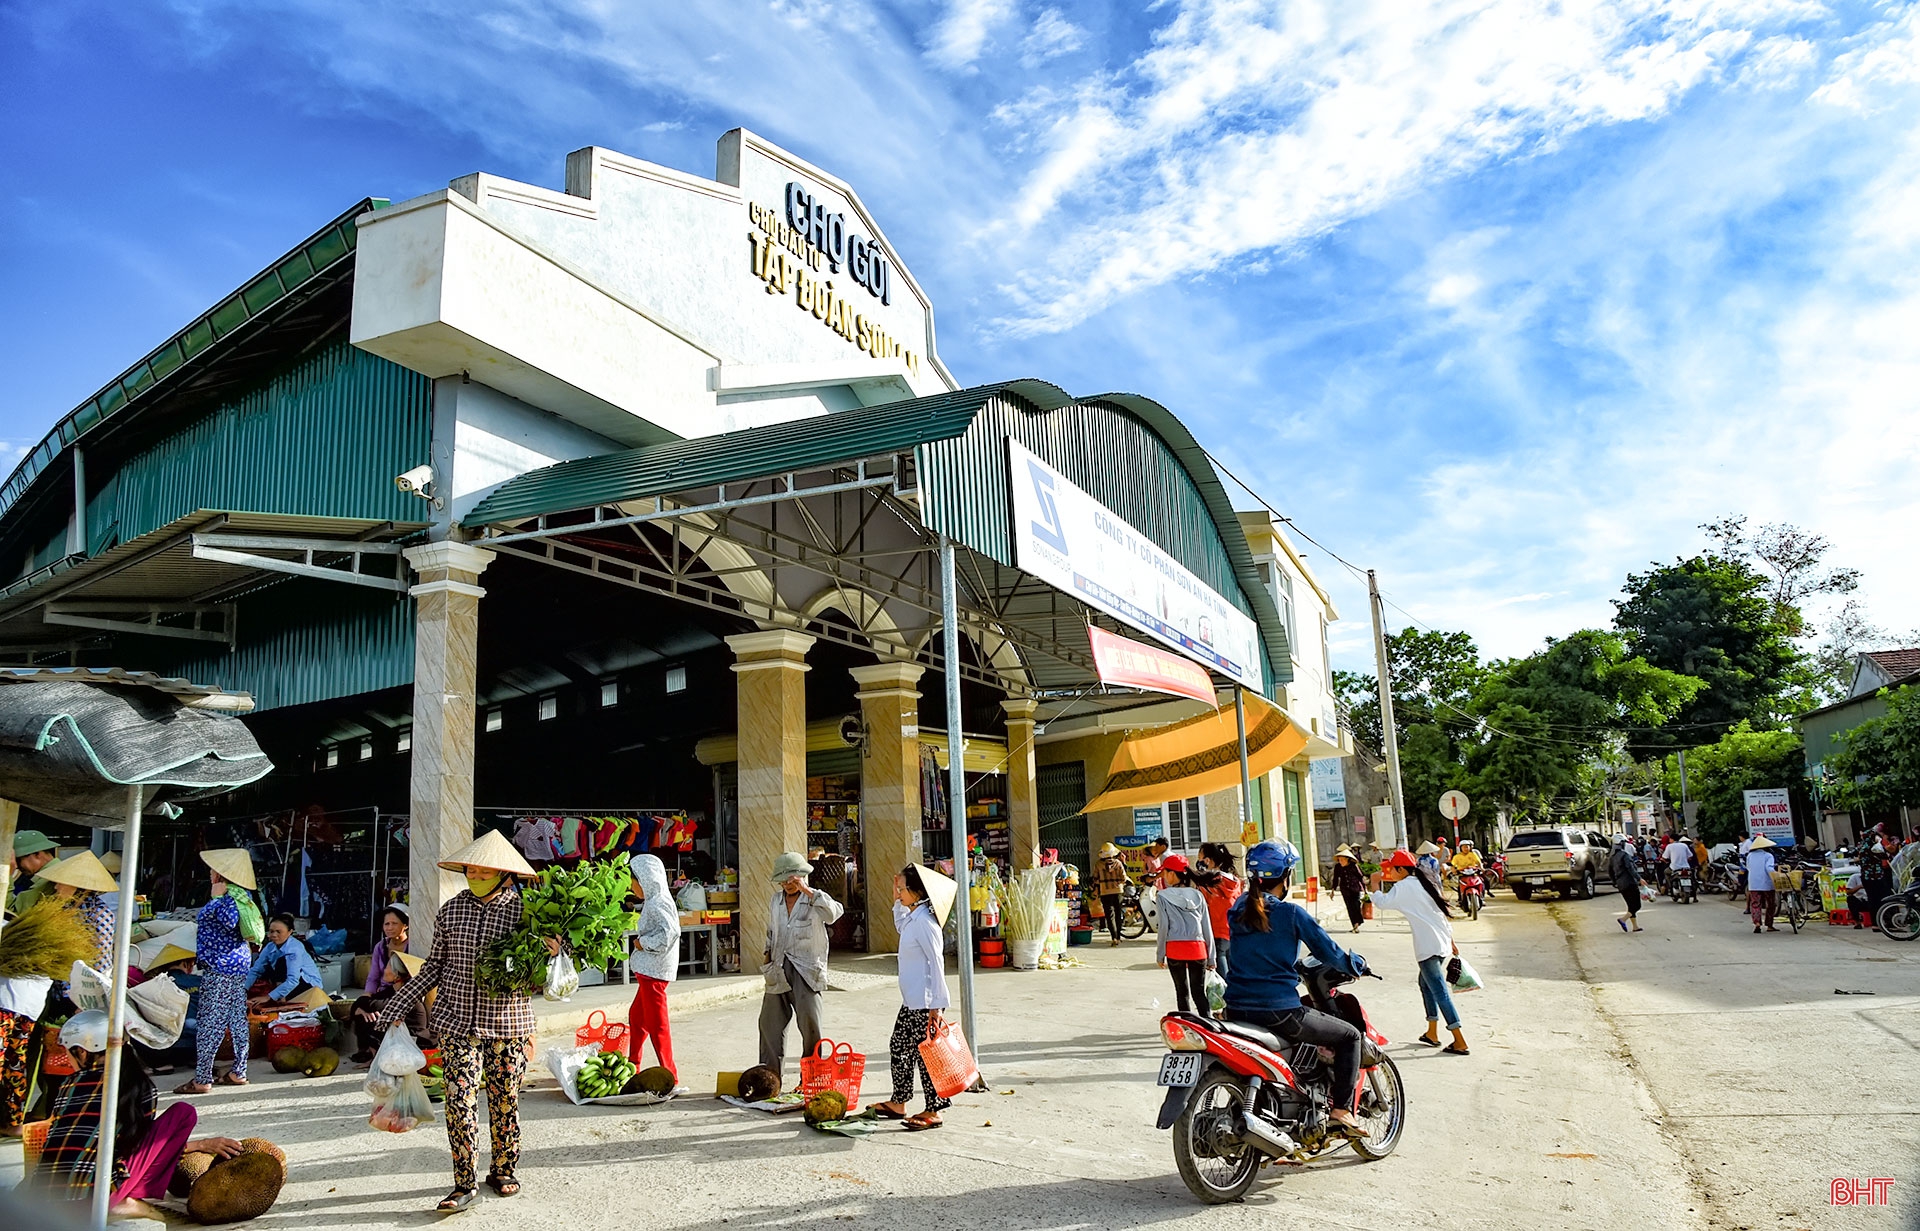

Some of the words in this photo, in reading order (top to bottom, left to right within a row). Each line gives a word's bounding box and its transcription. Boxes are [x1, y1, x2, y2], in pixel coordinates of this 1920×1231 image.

[785, 181, 846, 274] CHỢ
[848, 234, 891, 306] GÔI
[747, 231, 793, 295] TẬP
[796, 269, 854, 343] ĐOÀN
[1094, 511, 1124, 546] CÔNG
[1126, 534, 1137, 555] TY
[1140, 542, 1152, 565] CỔ
[1176, 570, 1192, 593] SƠN
[1193, 583, 1203, 602] AN
[1750, 818, 1764, 827] HUY
[1766, 815, 1790, 826] HOÀNG
[1163, 1070, 1192, 1084] 6458
[1167, 1056, 1195, 1069] 38-P1
